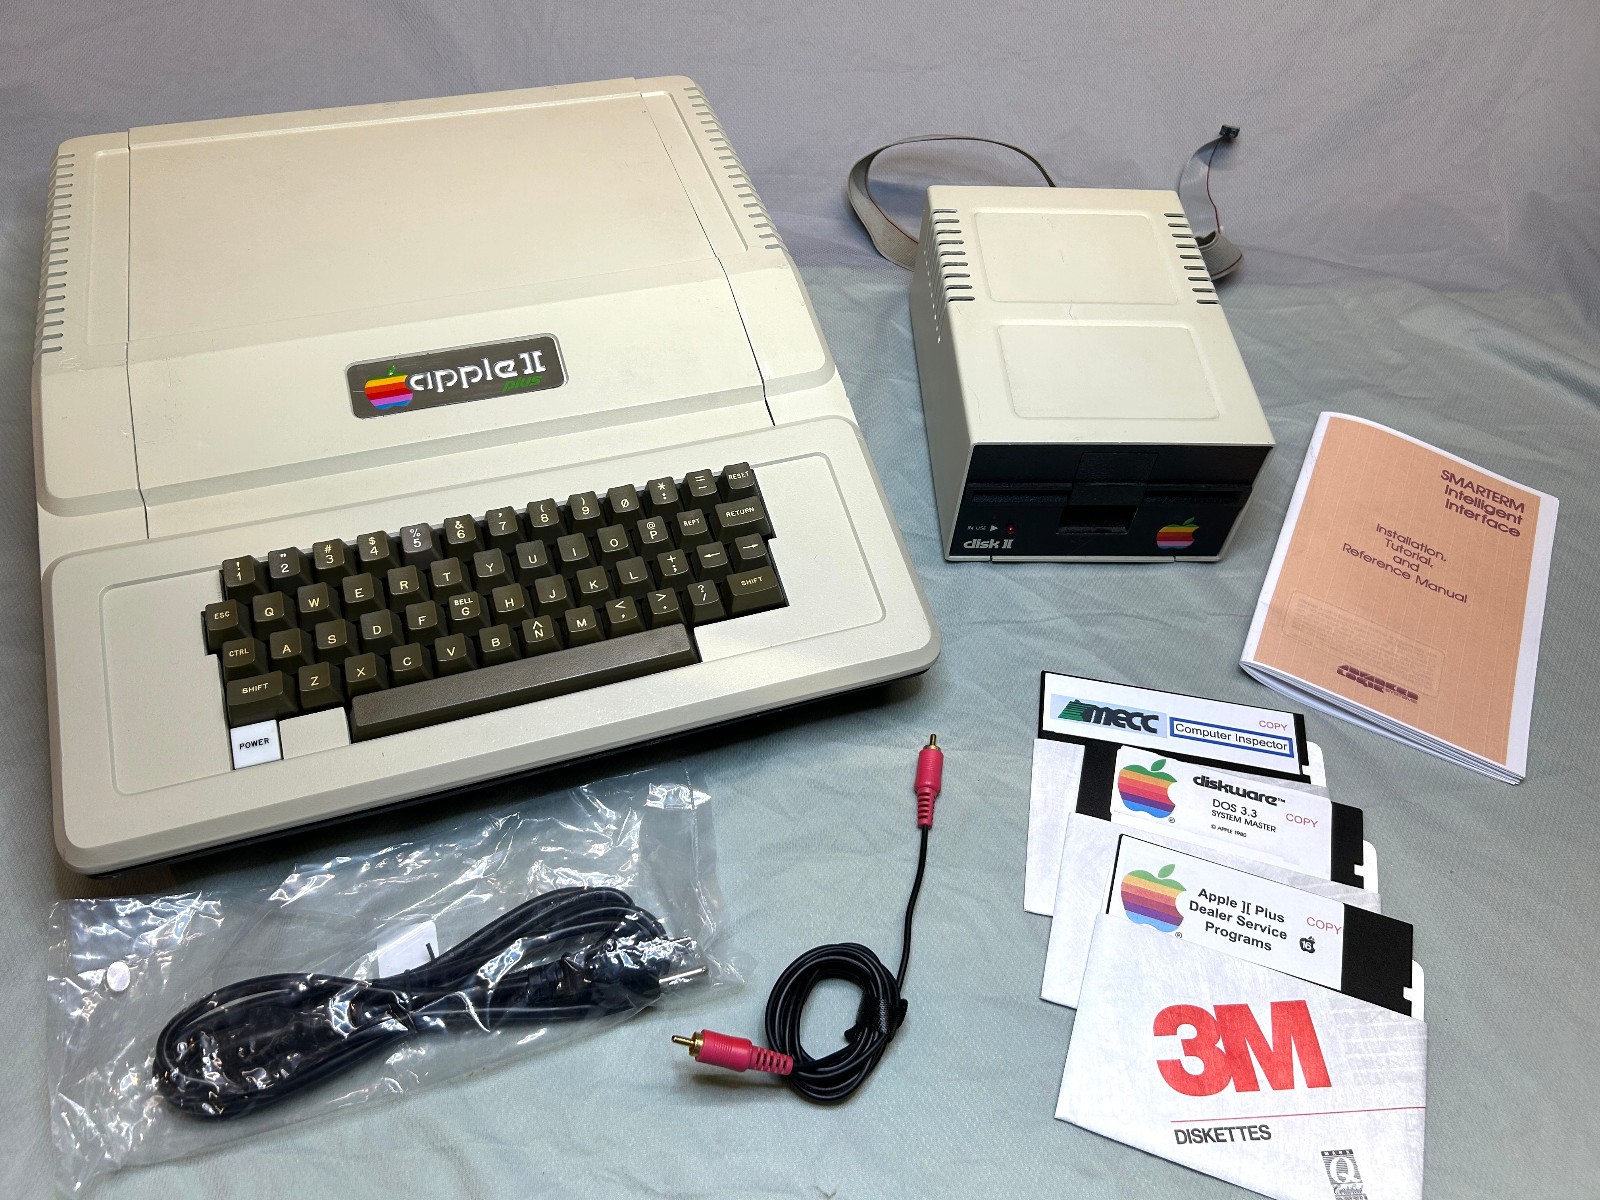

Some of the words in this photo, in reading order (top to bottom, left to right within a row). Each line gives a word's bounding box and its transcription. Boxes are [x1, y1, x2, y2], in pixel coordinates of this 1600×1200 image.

[408, 357, 518, 393] apple
[502, 374, 543, 394] plus
[728, 470, 750, 480] RESET
[1440, 469, 1525, 514] SMARTERM
[1444, 484, 1523, 526] Intelligent
[582, 506, 590, 516] 9
[725, 506, 756, 518] RETURN
[540, 513, 550, 523] 8
[683, 518, 700, 527] REPT
[1445, 498, 1521, 538] Interface
[454, 520, 464, 530] &
[499, 521, 507, 531] 7
[646, 522, 656, 530] @
[409, 529, 421, 538] %
[457, 529, 466, 538] 6
[650, 530, 658, 540] P
[368, 537, 376, 546] $
[414, 538, 422, 548] 5
[610, 538, 619, 548] O
[963, 538, 1000, 549] disk
[1376, 523, 1447, 562] Installation,
[324, 545, 332, 554] #
[370, 546, 379, 556] 4
[1385, 538, 1434, 568] Tutorial,
[326, 554, 334, 564] 3
[528, 554, 538, 564] U
[1392, 554, 1420, 572] and
[280, 564, 290, 573] 2
[486, 562, 494, 572] Y
[443, 572, 451, 582] T
[629, 571, 638, 580] L
[1342, 543, 1411, 580] Reference
[1415, 575, 1468, 604] Manual
[400, 580, 409, 590] R
[589, 580, 599, 590] K
[741, 576, 763, 586] SHIFT
[354, 588, 364, 598] E
[549, 589, 556, 599] J
[308, 598, 320, 608] W
[454, 598, 474, 606] BELL
[505, 598, 515, 608] H
[214, 611, 230, 620] ESC
[264, 607, 274, 616] Q
[461, 606, 470, 616] G
[418, 616, 427, 626] F
[576, 618, 587, 628] M
[373, 625, 382, 636] D
[327, 635, 337, 644] S
[491, 638, 501, 648] B
[229, 648, 250, 658] CTRL
[282, 644, 292, 654] A
[446, 647, 456, 657] V
[403, 657, 412, 666] C
[357, 667, 366, 678] X
[310, 676, 320, 686] Z
[242, 683, 269, 694] SHIFT
[1080, 701, 1159, 734] mecc
[1258, 720, 1288, 732] COPY
[1175, 723, 1232, 743] Computer
[1235, 733, 1288, 752] Inspector
[239, 737, 270, 750] POWER
[1212, 799, 1237, 813] DOS
[1240, 806, 1258, 818] 3.3
[1211, 809, 1242, 824] SYSTEM
[1244, 818, 1277, 833] MASTER
[1285, 813, 1318, 828] COPY
[1217, 826, 1233, 835] APPLE
[1198, 888, 1238, 910] Apple
[1255, 905, 1286, 924] Plus
[1189, 900, 1233, 923] Dealer
[1236, 915, 1288, 940] Service
[1306, 917, 1342, 935] COPY
[1205, 921, 1272, 952] Programs
[1153, 1000, 1332, 1097] 3M
[1174, 1124, 1272, 1145] DISKETTES
